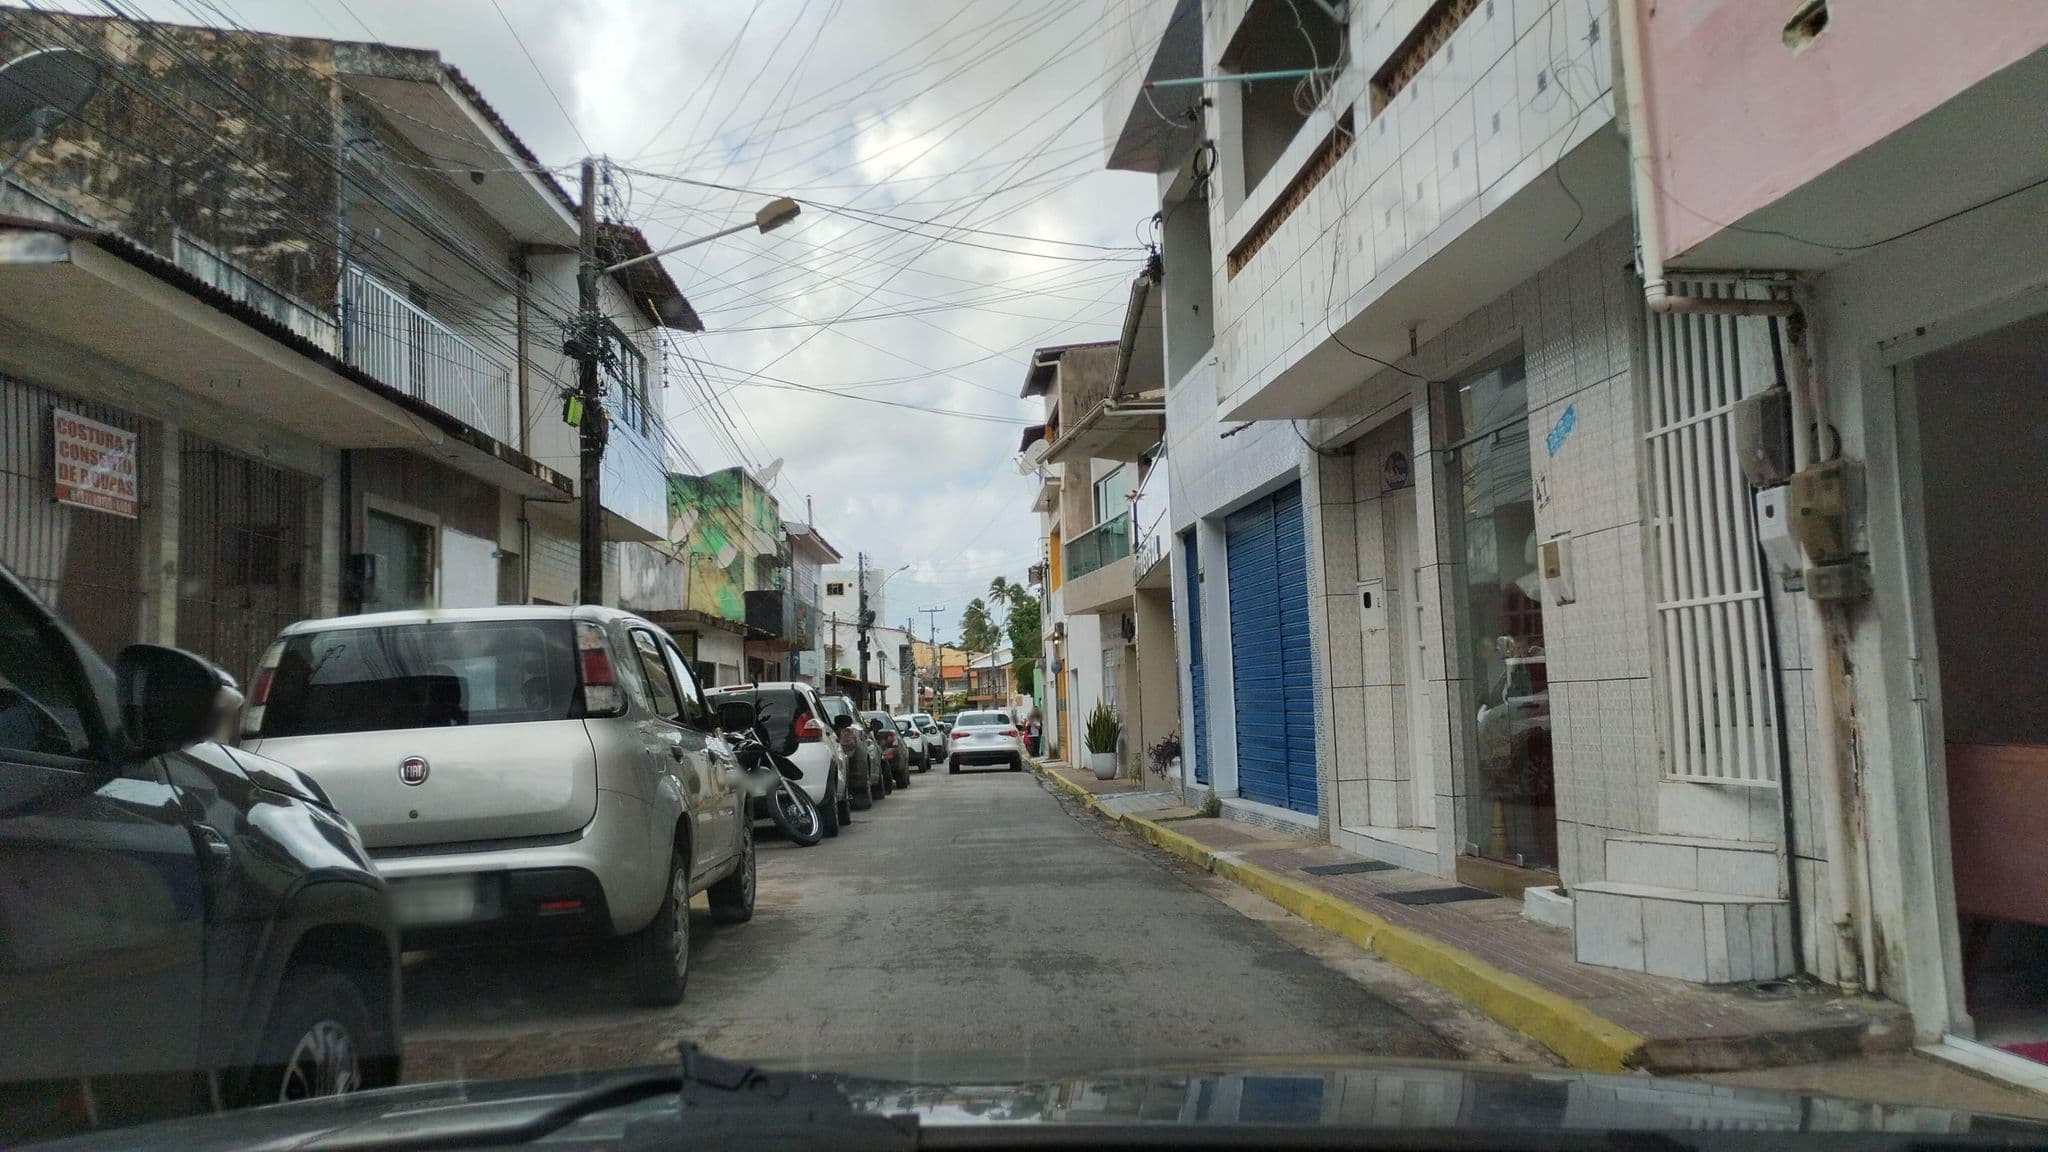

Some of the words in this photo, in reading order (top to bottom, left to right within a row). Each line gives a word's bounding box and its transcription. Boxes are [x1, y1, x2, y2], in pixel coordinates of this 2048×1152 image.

[57, 417, 124, 449] COSTURA
[58, 463, 76, 482] DE
[406, 765, 423, 778] FIAT
